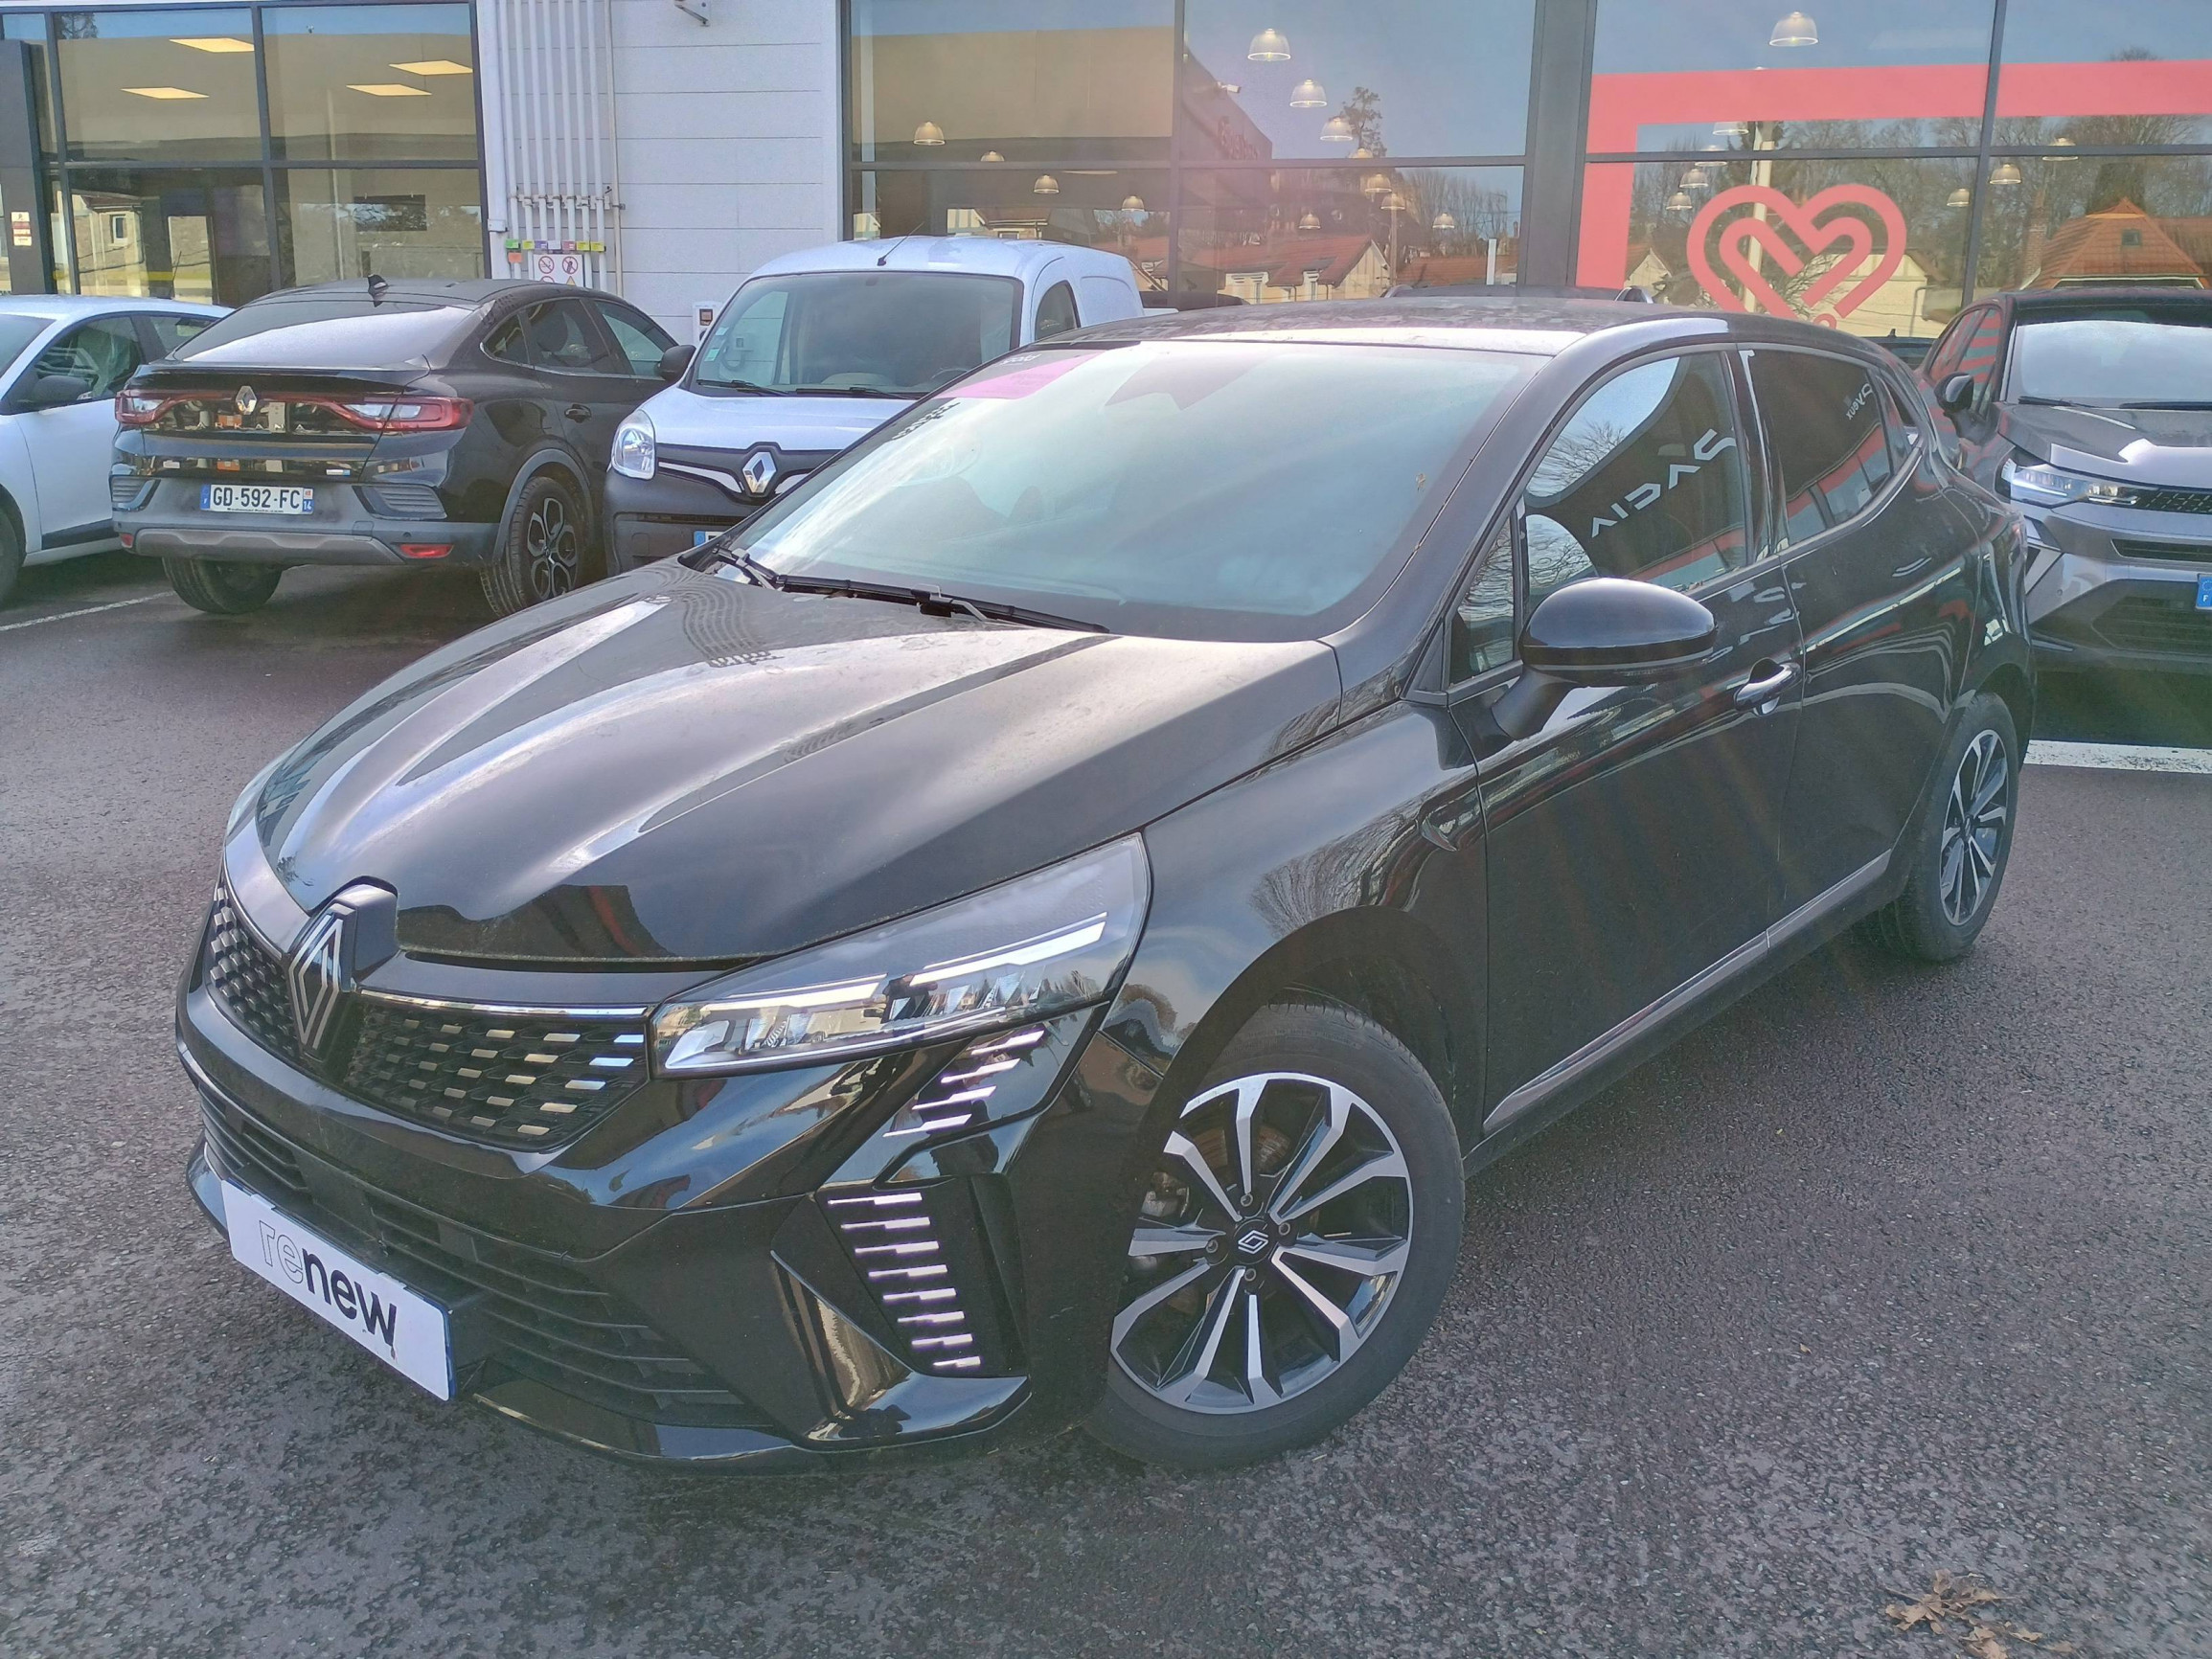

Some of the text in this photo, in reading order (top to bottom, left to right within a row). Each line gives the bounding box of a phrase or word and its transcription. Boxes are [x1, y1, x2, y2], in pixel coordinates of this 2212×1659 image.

[213, 487, 301, 509] GD-592-FC
[2202, 594, 2209, 602] F
[259, 1219, 398, 1346] renew
